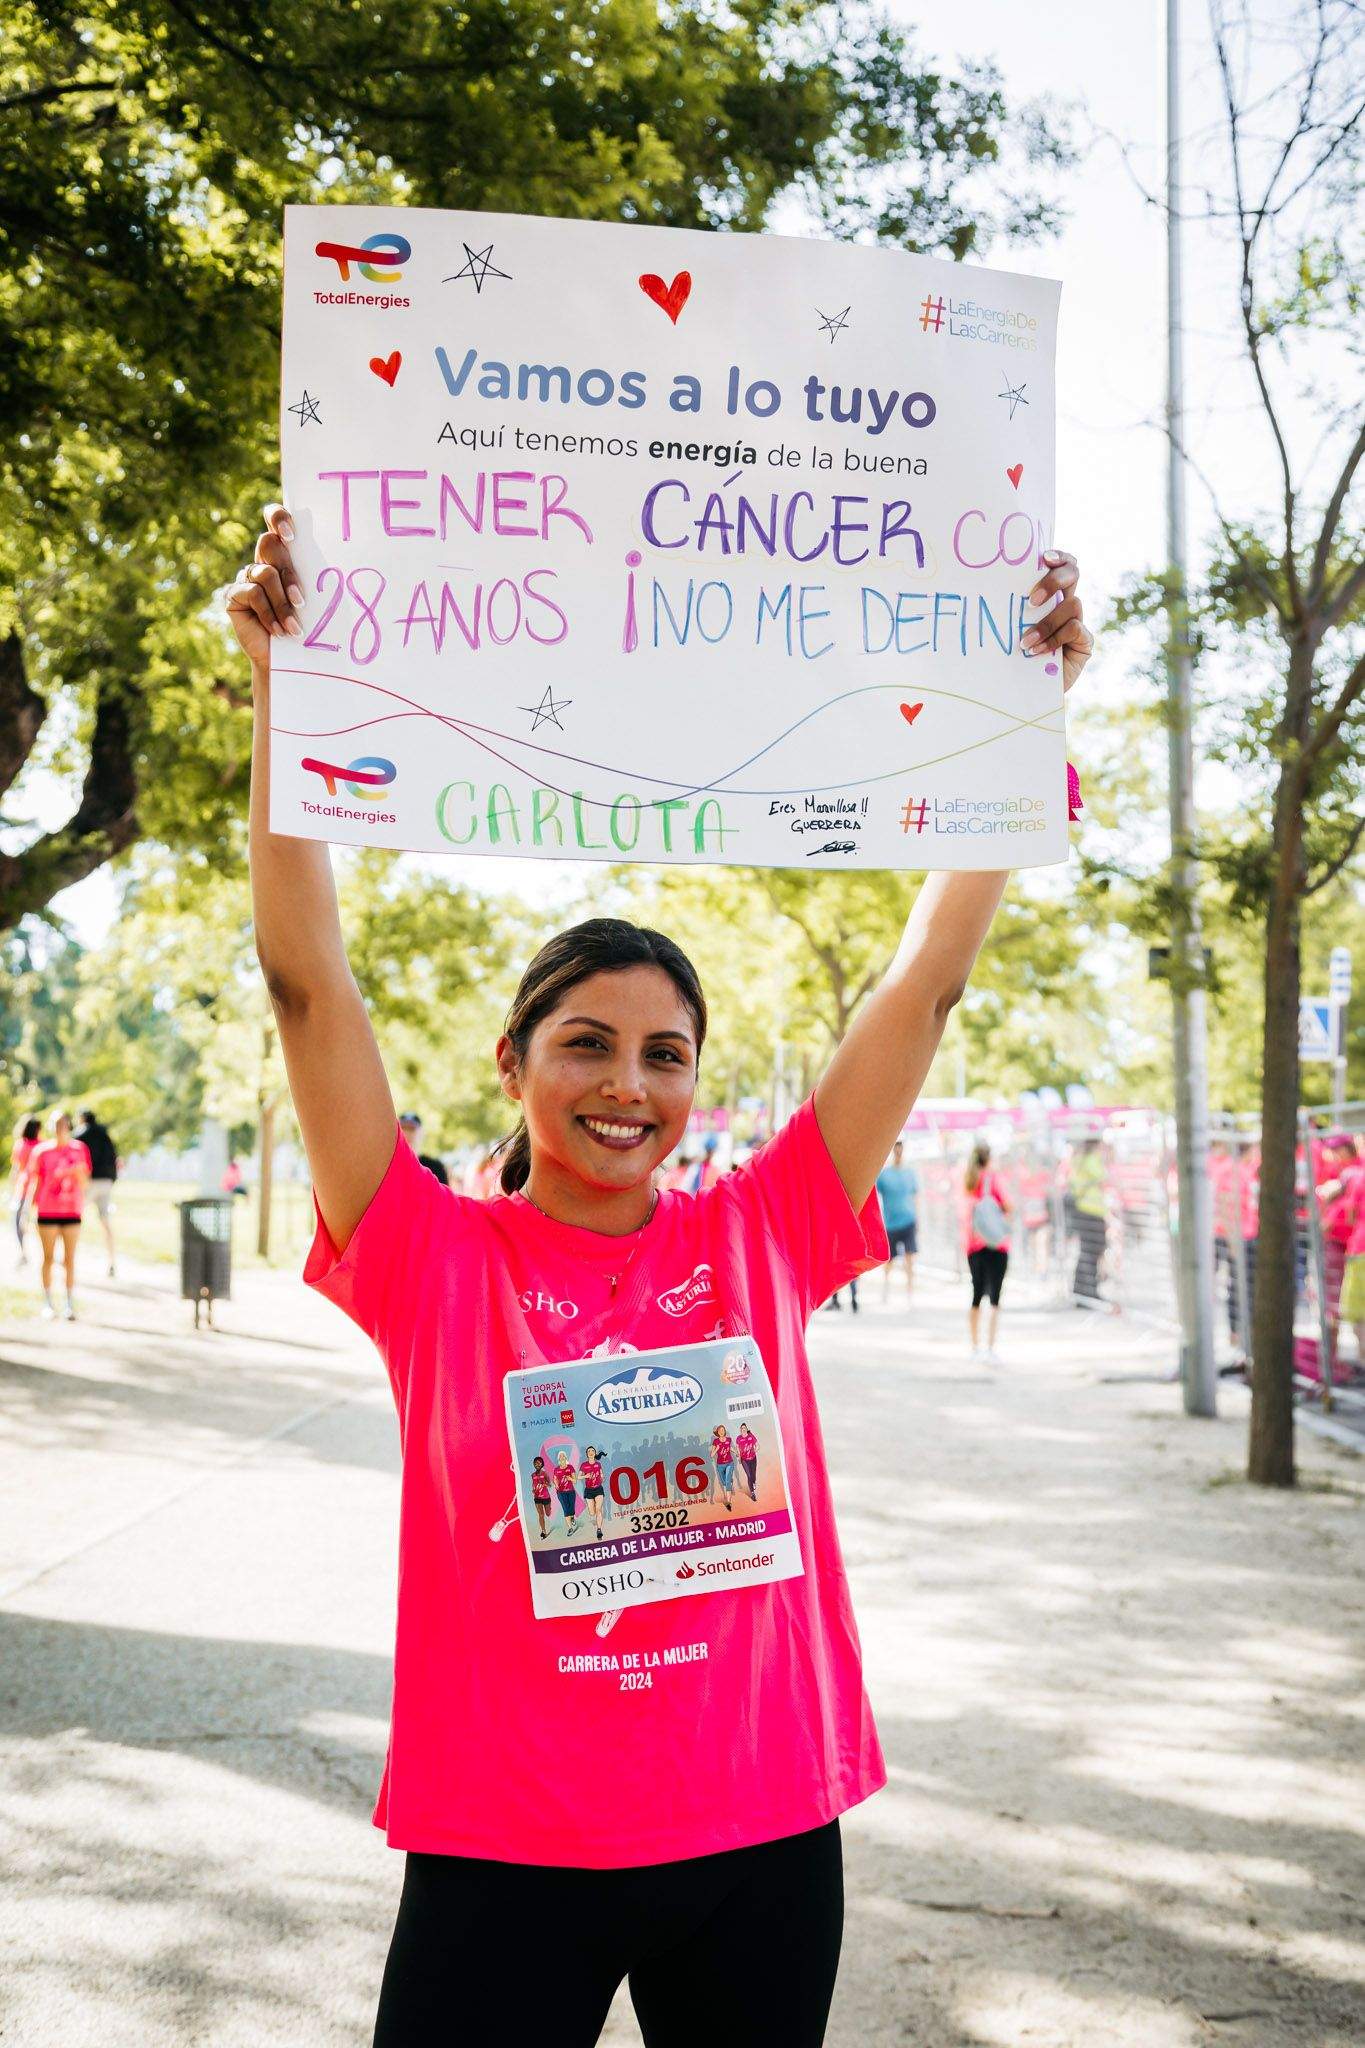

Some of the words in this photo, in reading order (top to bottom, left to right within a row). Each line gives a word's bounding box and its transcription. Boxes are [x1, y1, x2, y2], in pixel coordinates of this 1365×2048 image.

[313, 292, 410, 309] TotalEnergies
[949, 317, 1038, 352] LasCarreras
[434, 346, 646, 409] Vamos
[669, 375, 702, 413] a
[726, 366, 782, 418] lo
[804, 375, 937, 435] tuyo
[437, 421, 504, 451] Aquí
[515, 427, 638, 457] tenemos
[648, 439, 757, 468] energía
[768, 444, 801, 468] de
[812, 446, 834, 470] la
[845, 448, 928, 475] buena
[318, 470, 594, 544] TENER
[641, 470, 924, 568] CÁNCER
[303, 566, 386, 666] 28
[394, 564, 569, 655] AÑOS
[757, 583, 835, 660] ME
[301, 801, 397, 824] TotalEnergies
[435, 781, 740, 854] CARLOTA
[768, 801, 796, 816] Eres
[791, 819, 861, 834] GUERRERA
[935, 818, 1047, 833] LasCarreras
[519, 1290, 579, 1319] SHO
[522, 1387, 532, 1395] TU
[534, 1381, 567, 1393] DORSAL
[523, 1390, 568, 1409] SUMA
[596, 1387, 696, 1415] ASTURIANA
[609, 1456, 709, 1505] 016
[630, 1509, 689, 1534] 33202
[560, 1549, 618, 1566] CARRERA
[622, 1542, 638, 1556] DE
[641, 1538, 657, 1552] LA
[661, 1531, 704, 1549] MUJER
[715, 1520, 767, 1540] MADRID
[562, 1570, 645, 1600] OYSHO
[697, 1553, 775, 1577] Santander
[558, 1655, 619, 1673] CARRERA
[623, 1654, 641, 1669] DE
[644, 1652, 660, 1667] LA
[663, 1642, 709, 1665] MUJER
[619, 1672, 653, 1691] 2024
